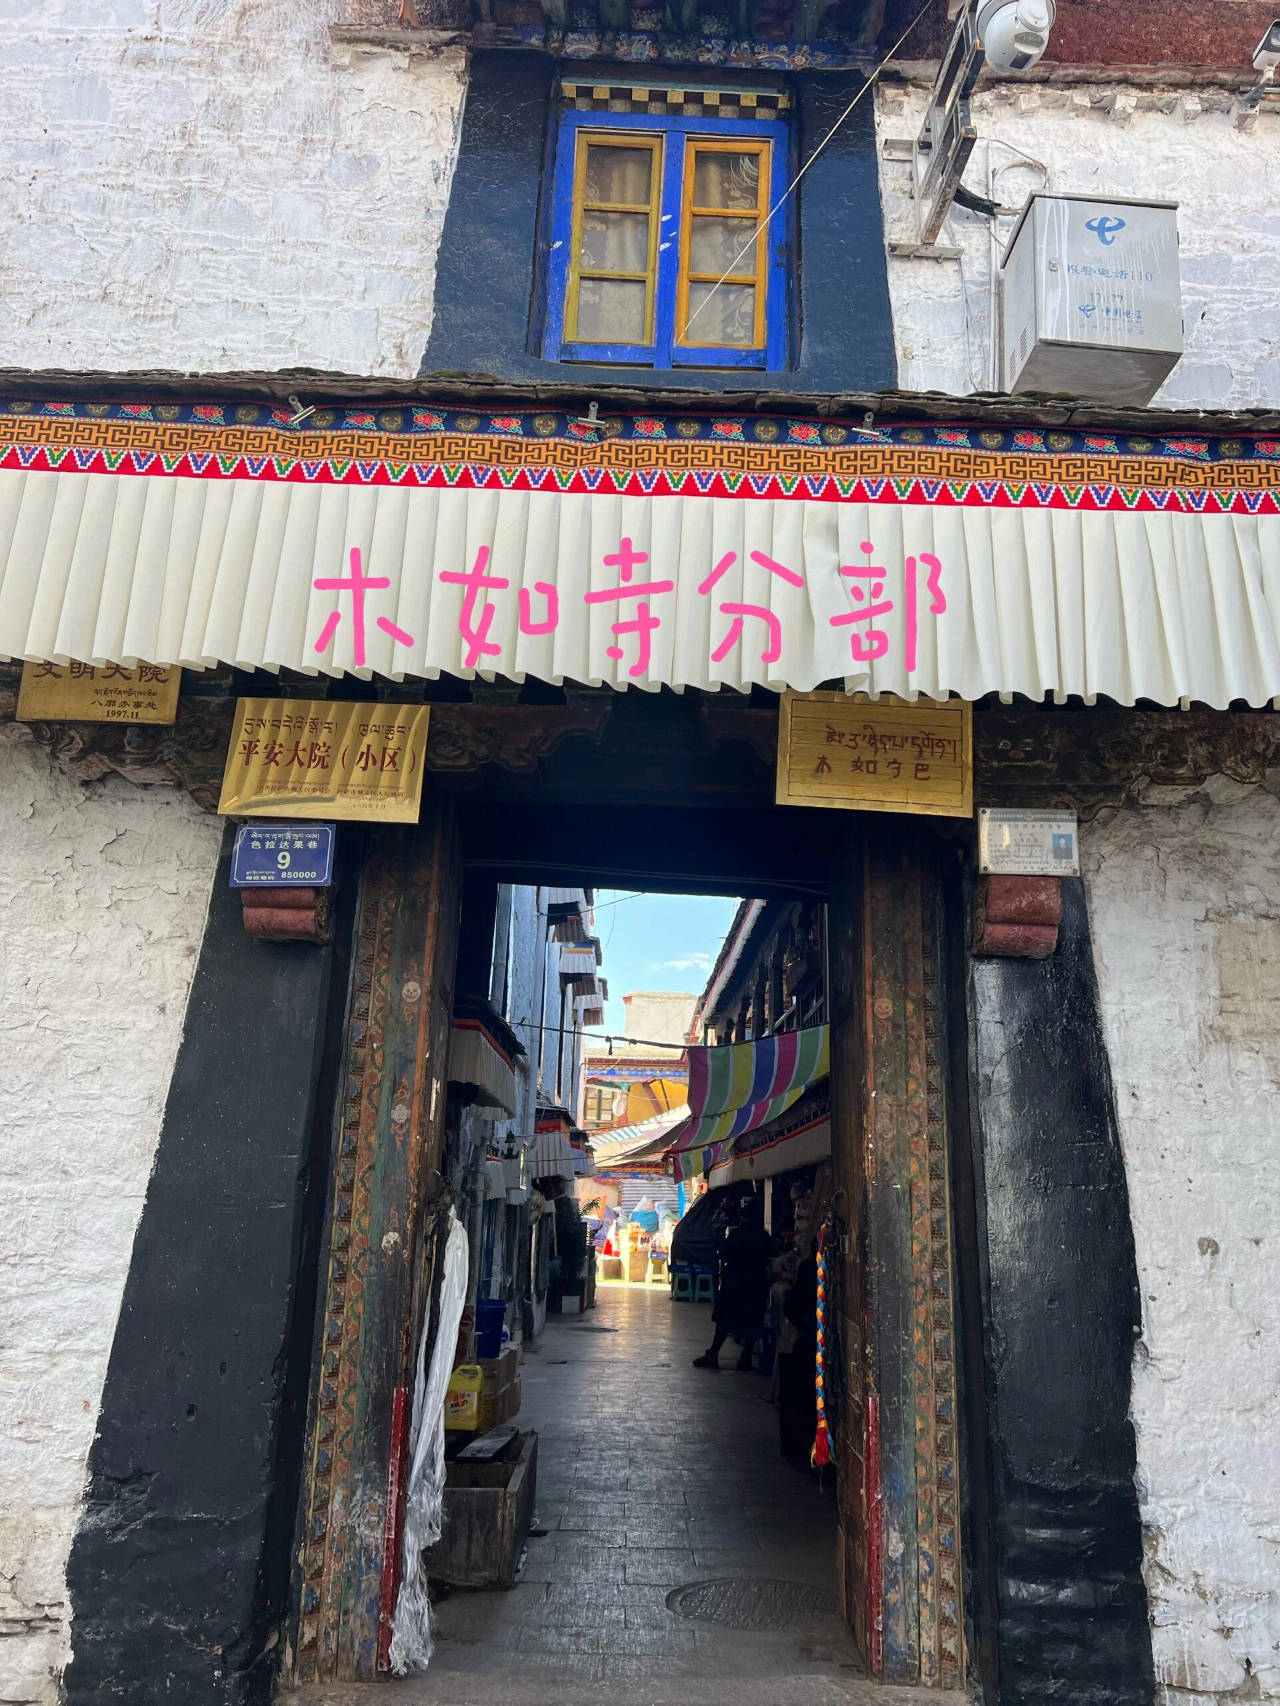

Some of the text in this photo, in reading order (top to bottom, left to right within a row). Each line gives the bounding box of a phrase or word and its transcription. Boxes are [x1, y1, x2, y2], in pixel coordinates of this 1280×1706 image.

[250, 840, 318, 849] 色拉达果巷
[276, 851, 291, 869] 9
[280, 871, 317, 879] 850000
